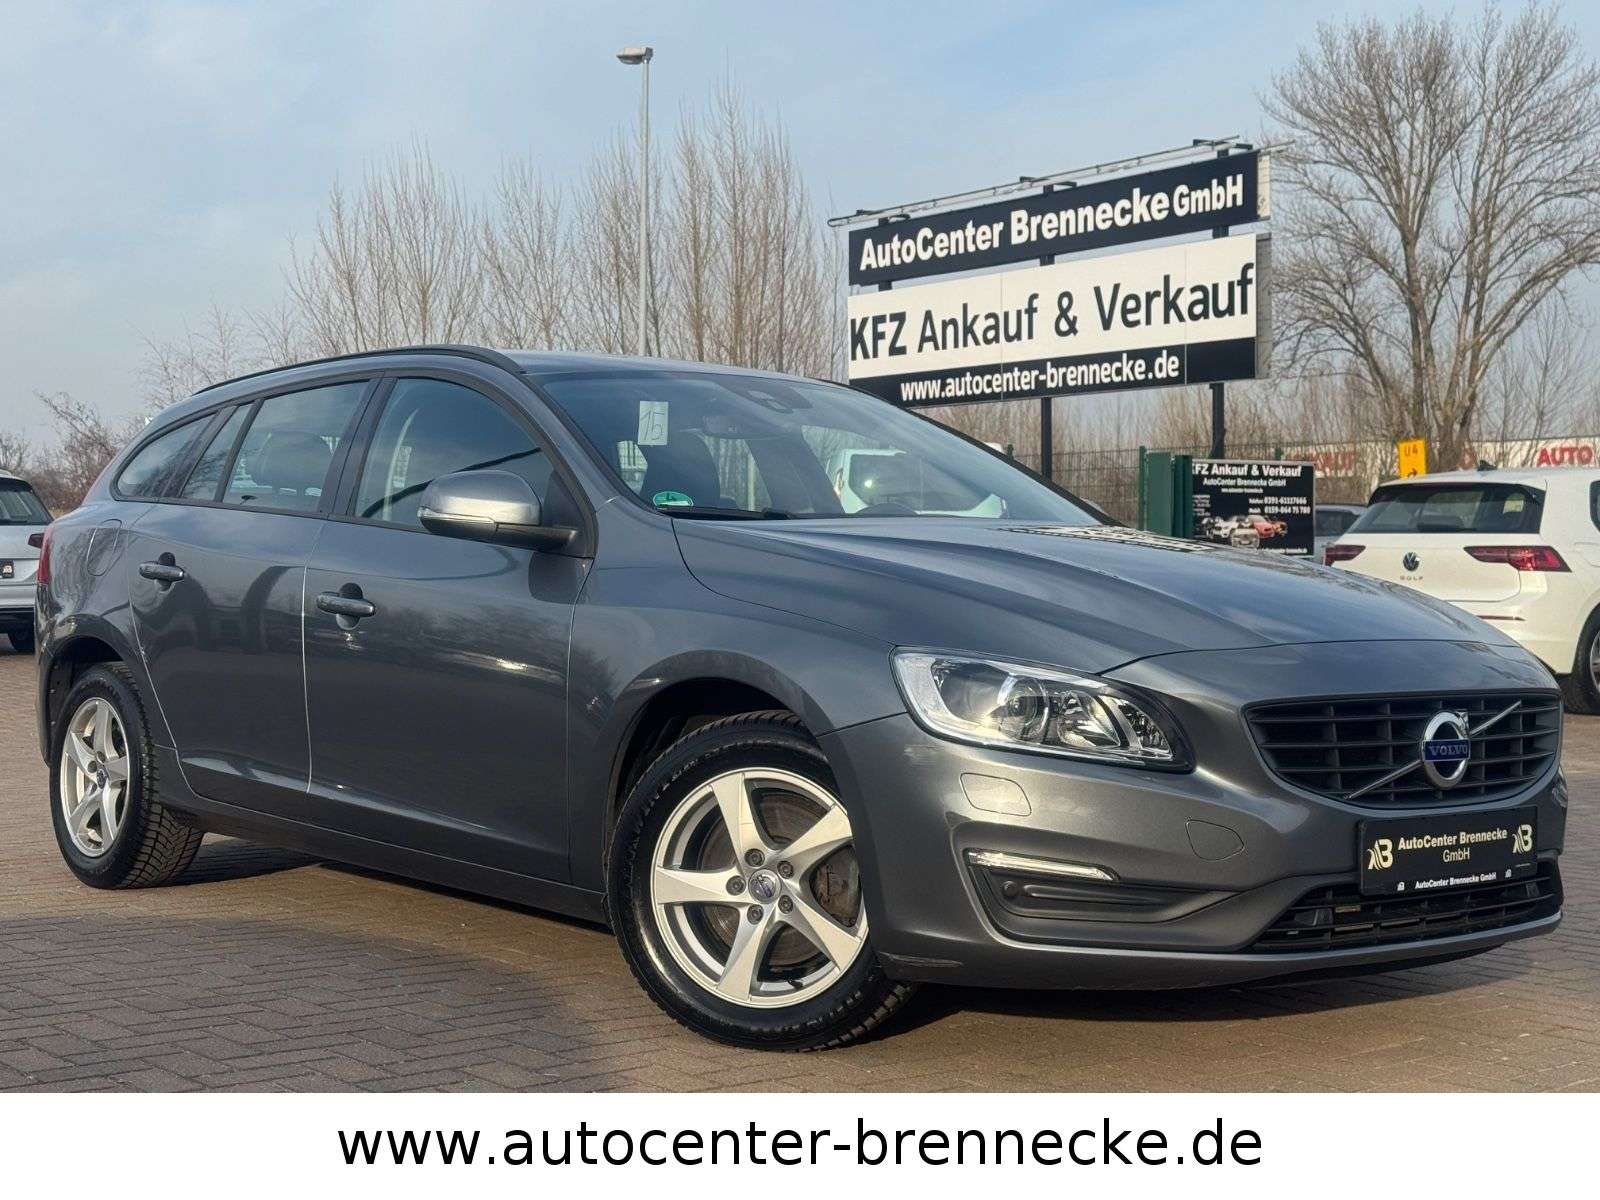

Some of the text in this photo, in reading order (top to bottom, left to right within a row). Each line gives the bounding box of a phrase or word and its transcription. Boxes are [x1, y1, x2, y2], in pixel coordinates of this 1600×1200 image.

[859, 173, 1244, 271] AutoCenter Brennecke GmbH
[849, 262, 1255, 361] KFZ Ankauf & Verkauf
[900, 349, 1180, 401] www.autocenter-brennecke.de
[1536, 446, 1594, 466] AUTO
[1211, 463, 1248, 476] Ankauf
[1251, 464, 1260, 476] &
[1262, 464, 1302, 477] Verkauf
[1428, 744, 1468, 756] VOLVO
[1398, 827, 1508, 850] AutoCenter Brennecke
[1442, 847, 1470, 863] GmbH
[1415, 879, 1448, 889] AutoCenter
[1449, 874, 1480, 886] Brennecke
[1480, 872, 1497, 882] GmbH
